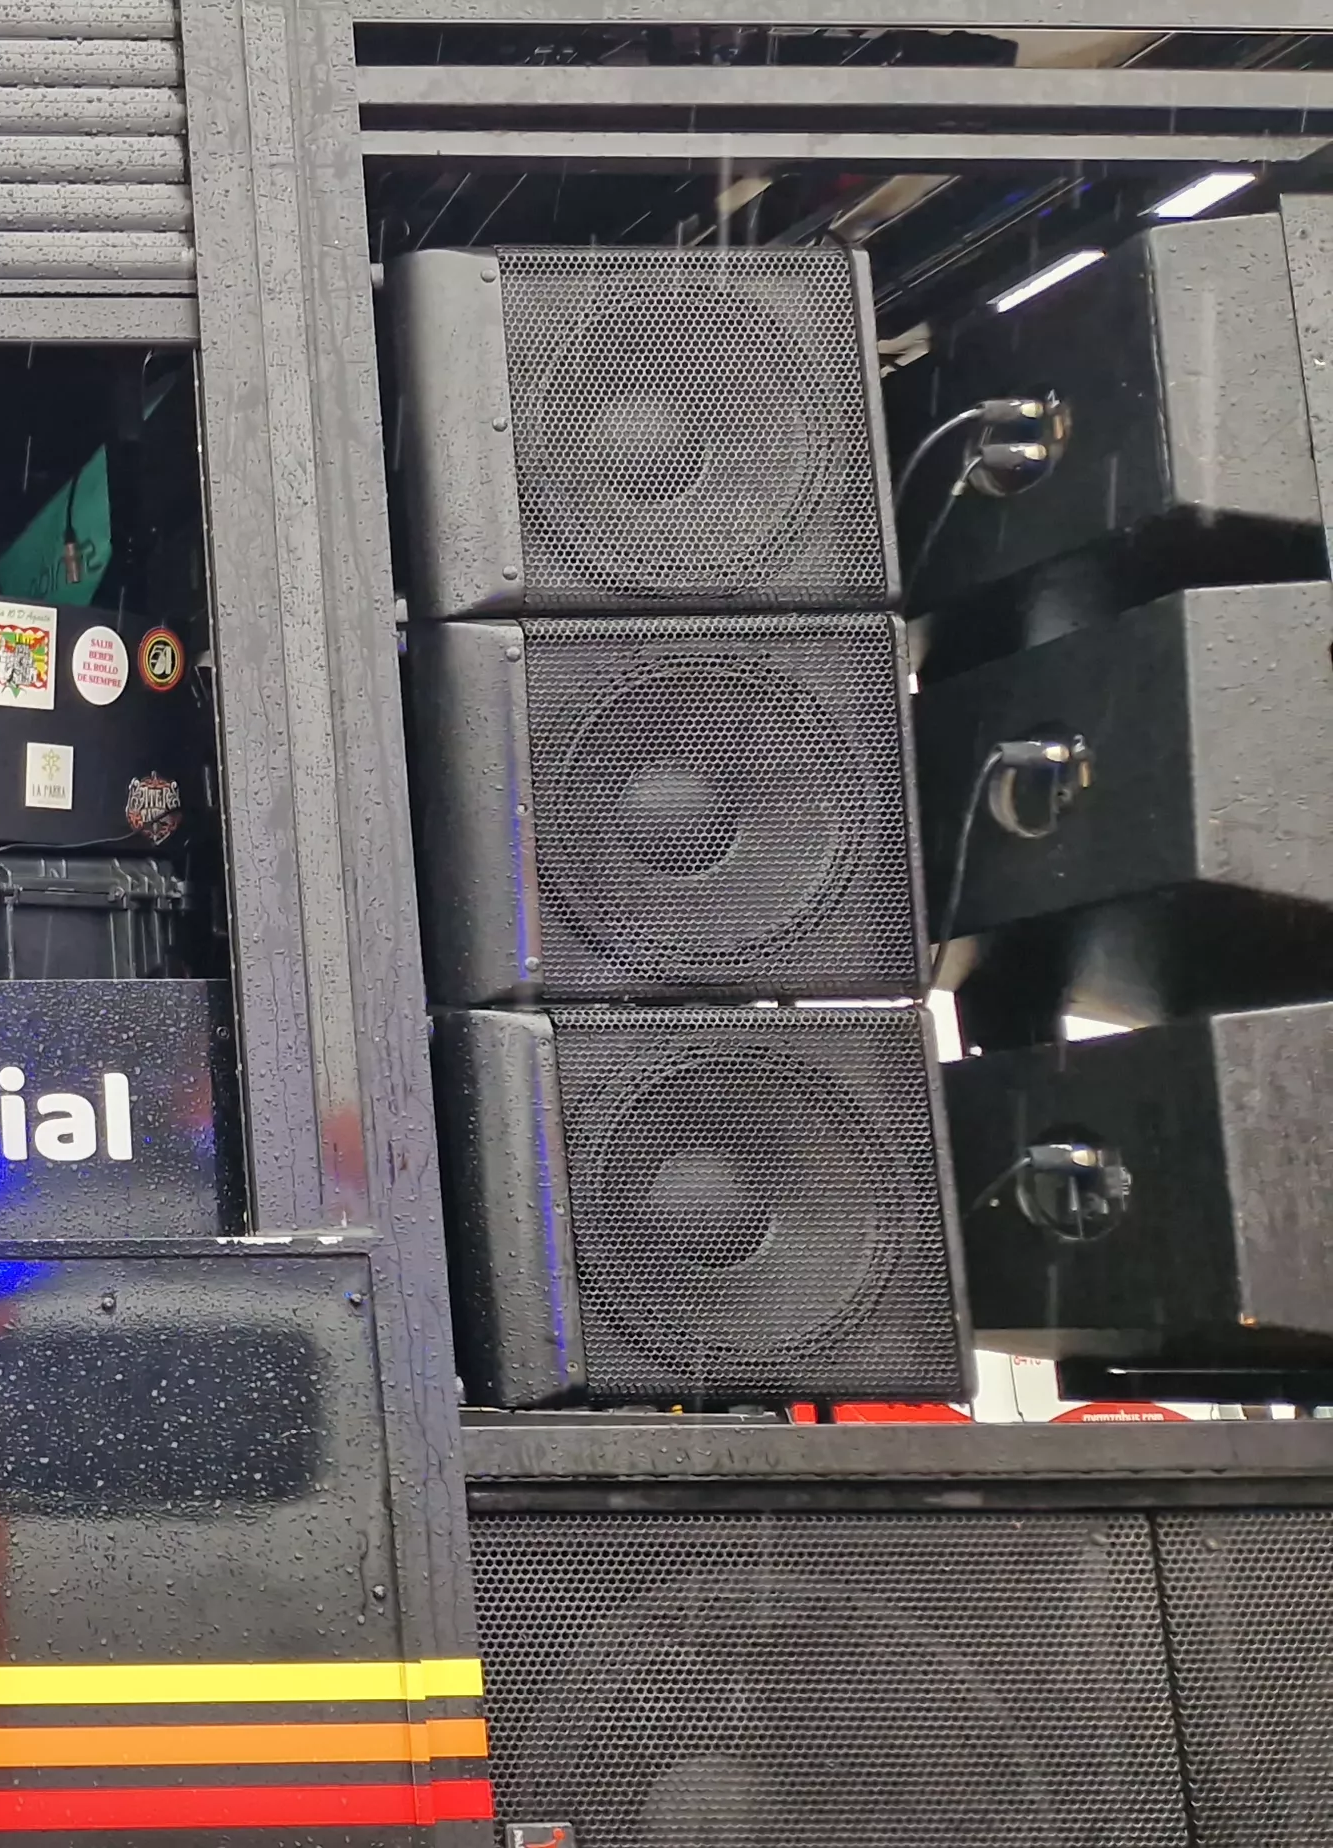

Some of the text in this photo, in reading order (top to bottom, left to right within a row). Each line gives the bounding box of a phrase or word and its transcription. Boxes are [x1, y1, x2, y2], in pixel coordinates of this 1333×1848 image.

[90, 638, 113, 650] SALIR
[88, 650, 114, 662] BEBER
[88, 674, 122, 688] SIEMPRE
